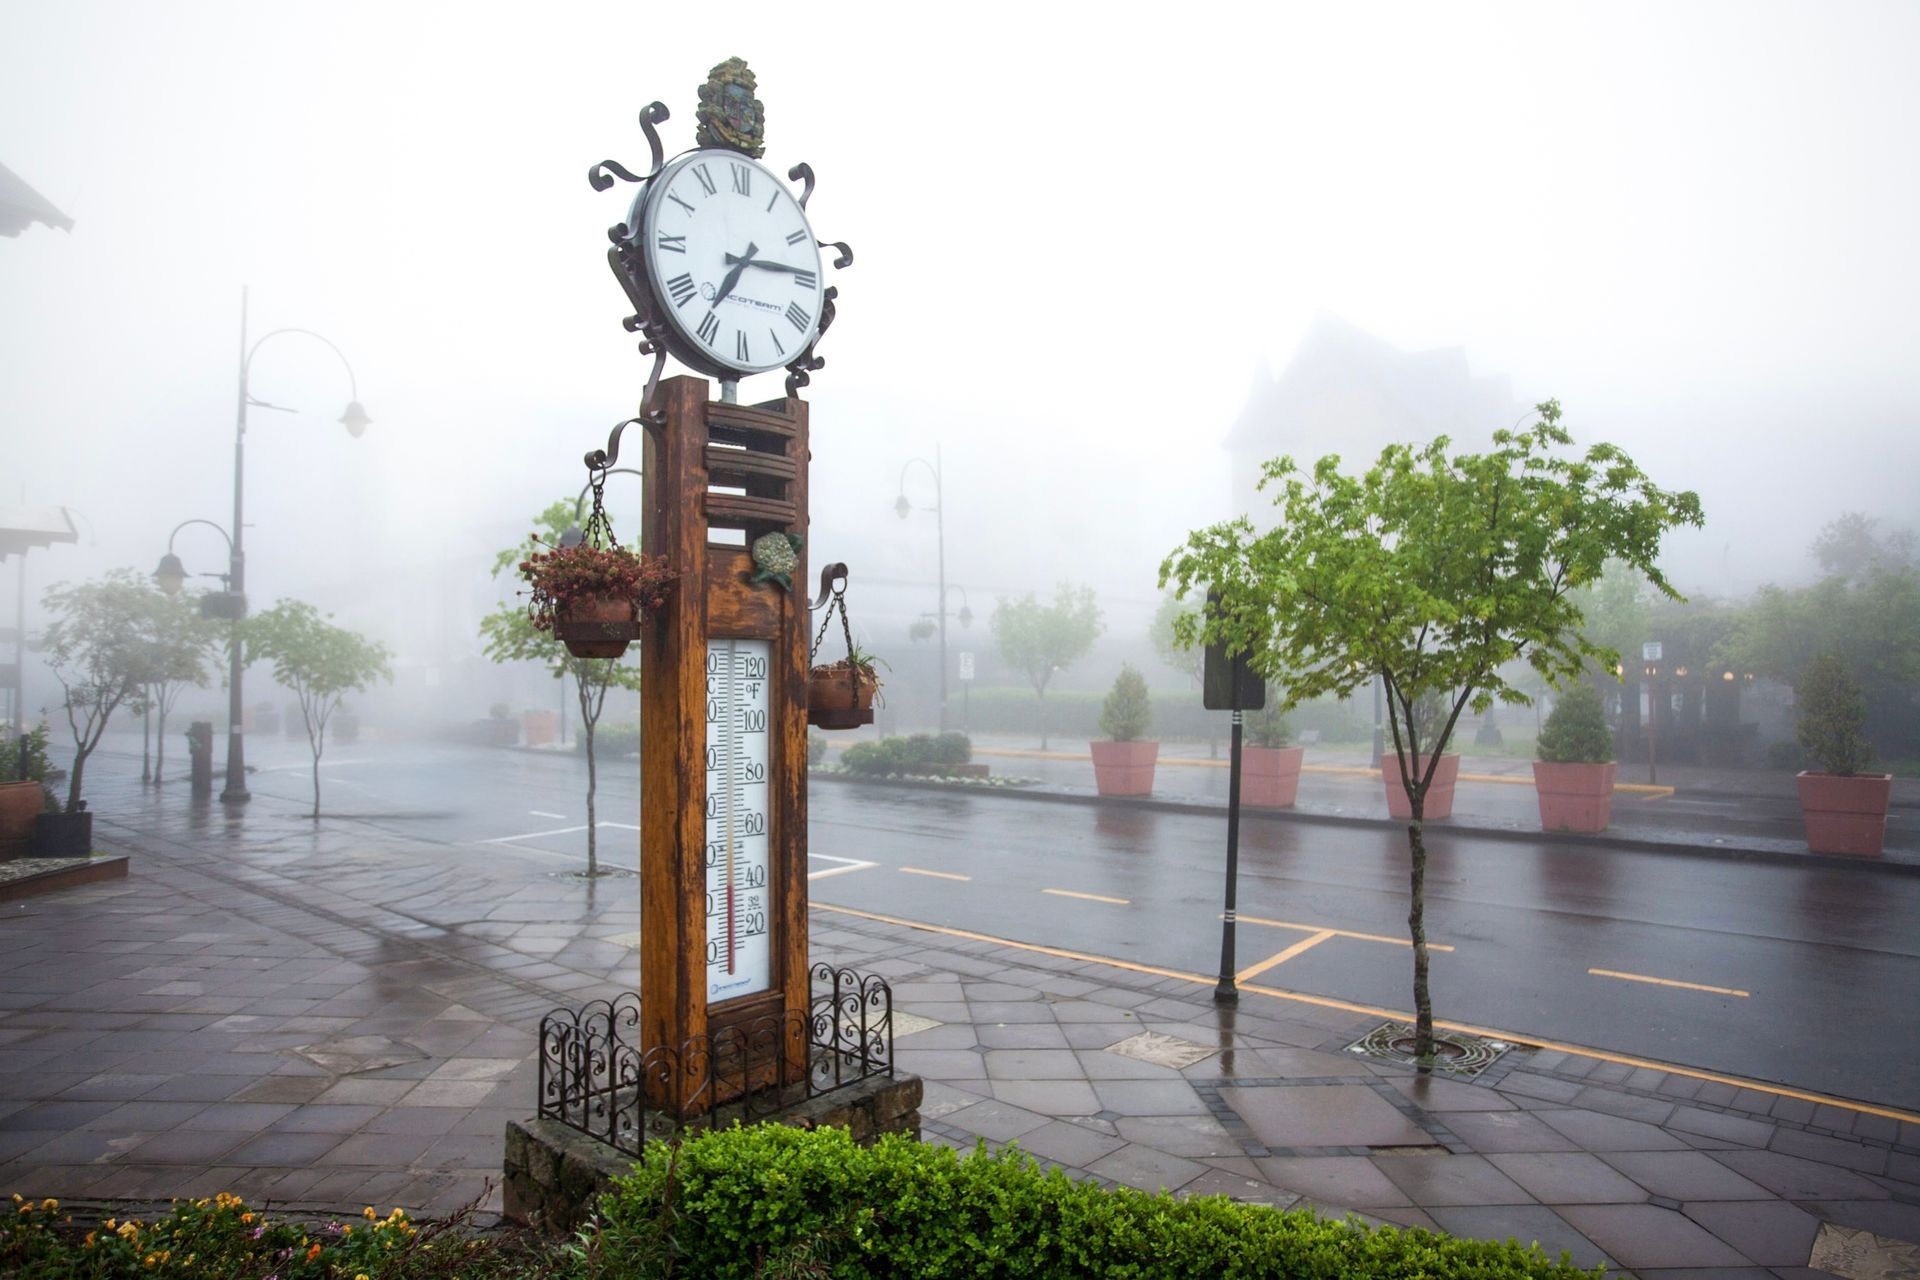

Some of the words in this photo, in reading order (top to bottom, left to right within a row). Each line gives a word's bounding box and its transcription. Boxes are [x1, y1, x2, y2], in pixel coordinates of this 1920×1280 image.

[691, 162, 717, 198] XI
[730, 162, 751, 197] XII
[667, 188, 695, 218] X
[785, 229, 807, 246] II
[727, 294, 782, 311] COTERM
[707, 652, 717, 673] 0
[744, 656, 766, 678] 120
[706, 676, 716, 695] C
[707, 699, 717, 722] 0
[743, 709, 765, 731] 100
[706, 747, 717, 770] 0
[745, 762, 764, 781] 80
[706, 795, 716, 818] 0
[745, 812, 764, 834] 60
[706, 844, 716, 866] 0
[745, 864, 764, 886] 40
[745, 911, 764, 934] 20
[706, 941, 717, 963] 0
